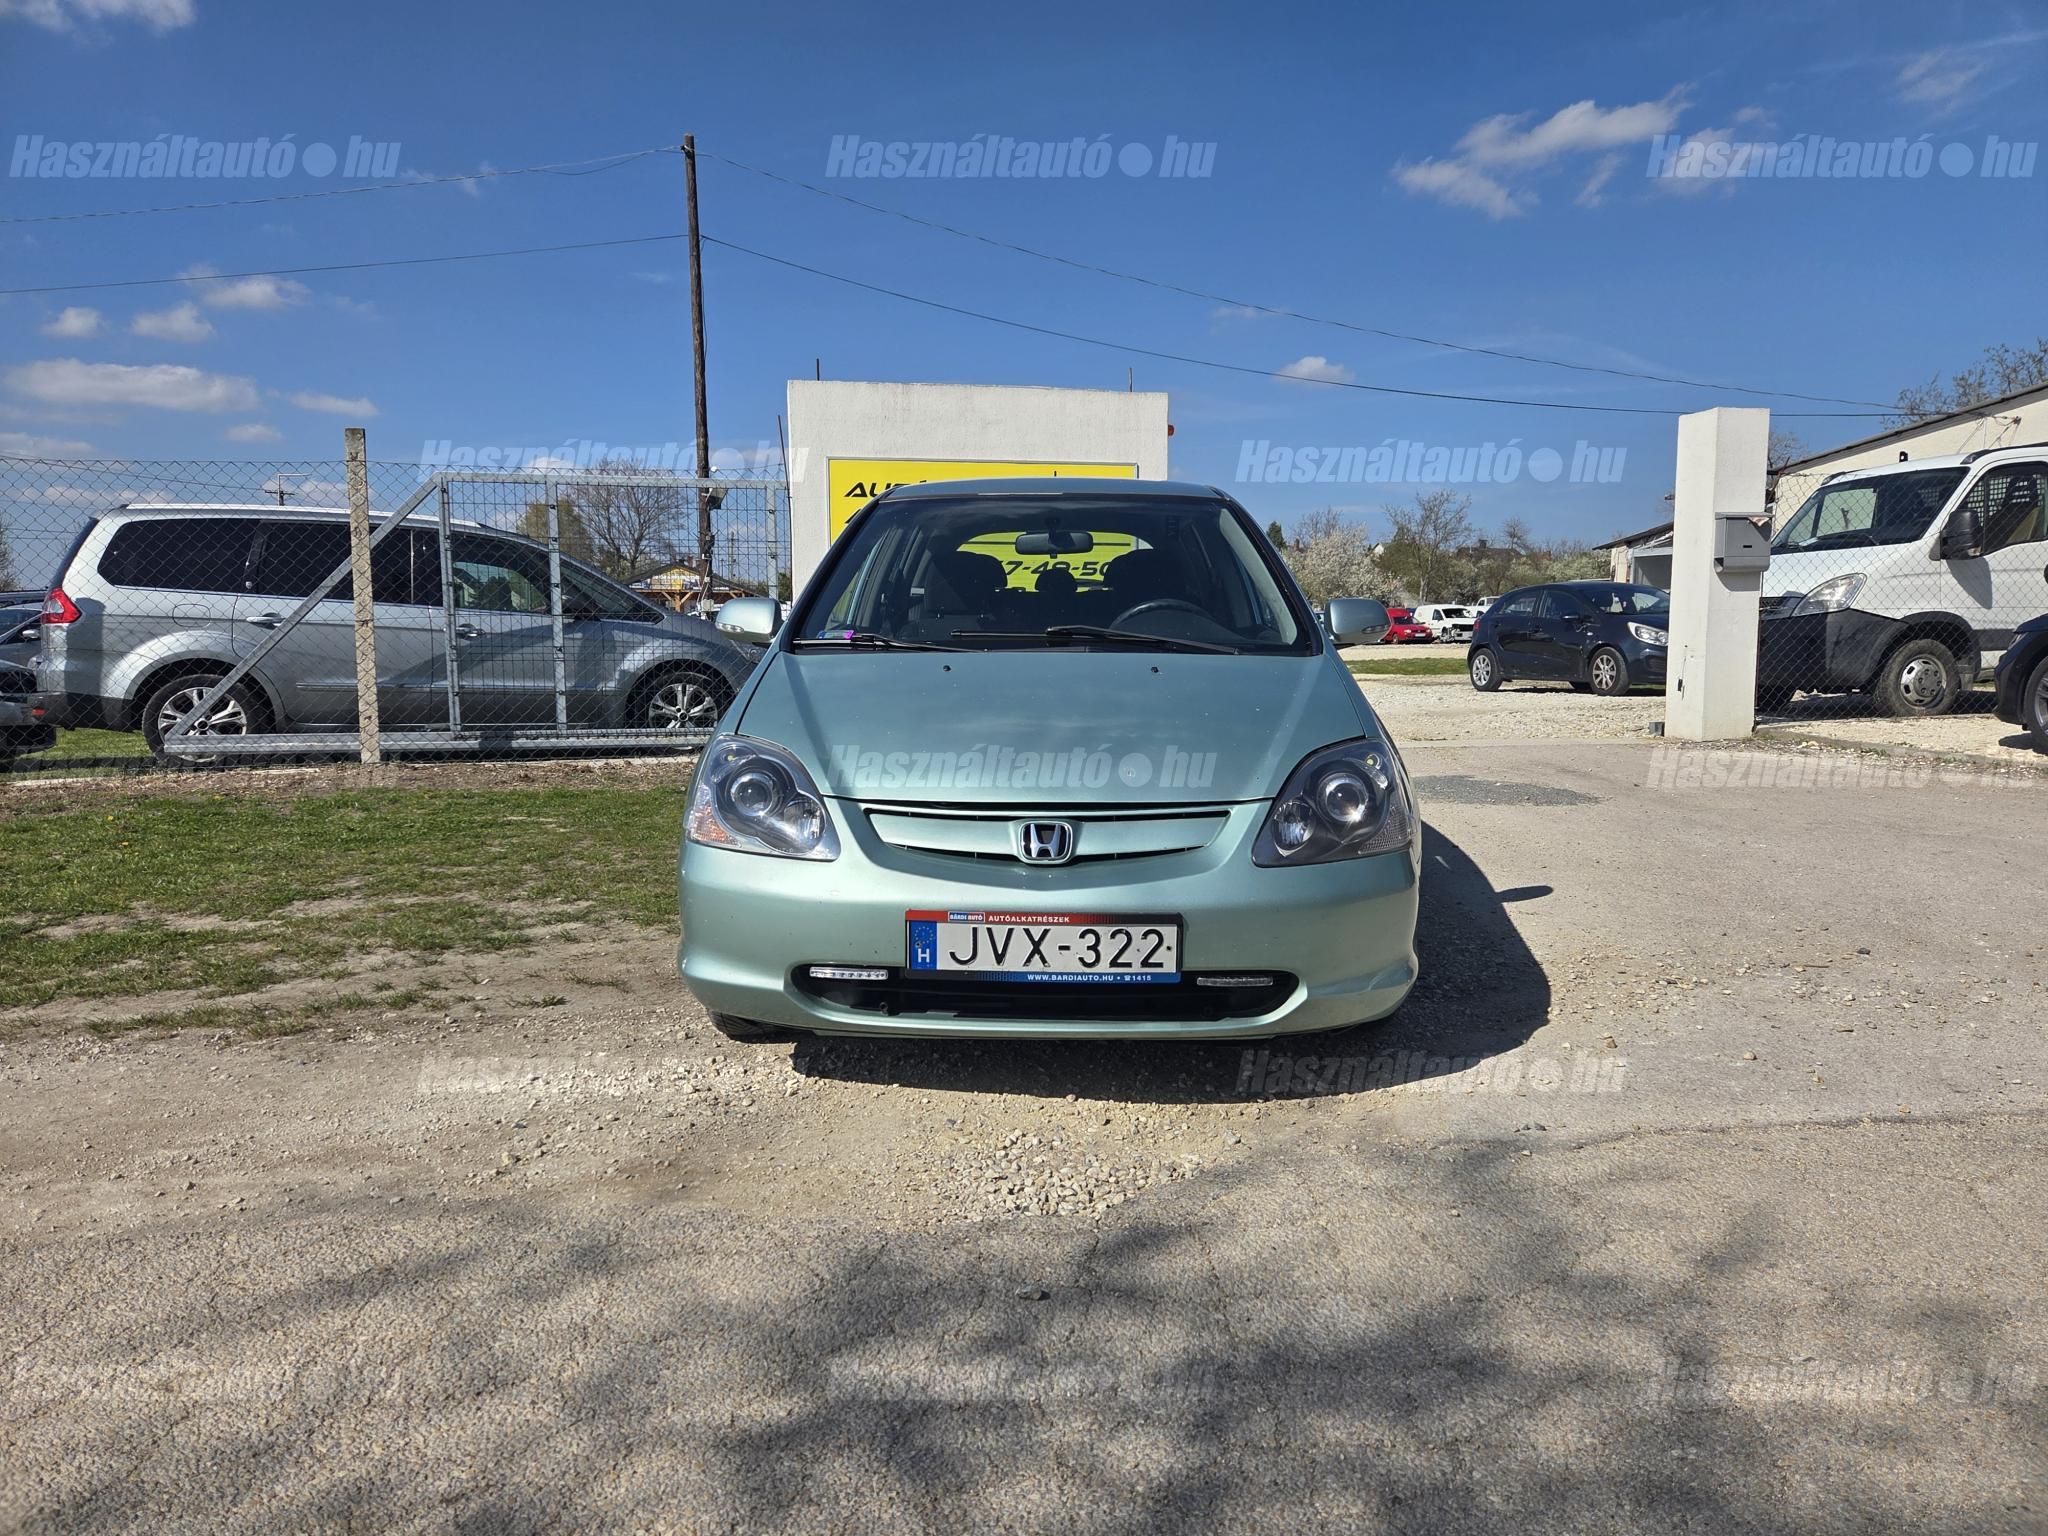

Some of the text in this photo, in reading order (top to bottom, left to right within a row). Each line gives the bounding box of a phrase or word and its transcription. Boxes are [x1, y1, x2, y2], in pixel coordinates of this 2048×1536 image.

[988, 914, 1070, 923] AUTÓALKATRÉSZEK
[949, 926, 1165, 968] JVX-322
[917, 948, 930, 963] H
